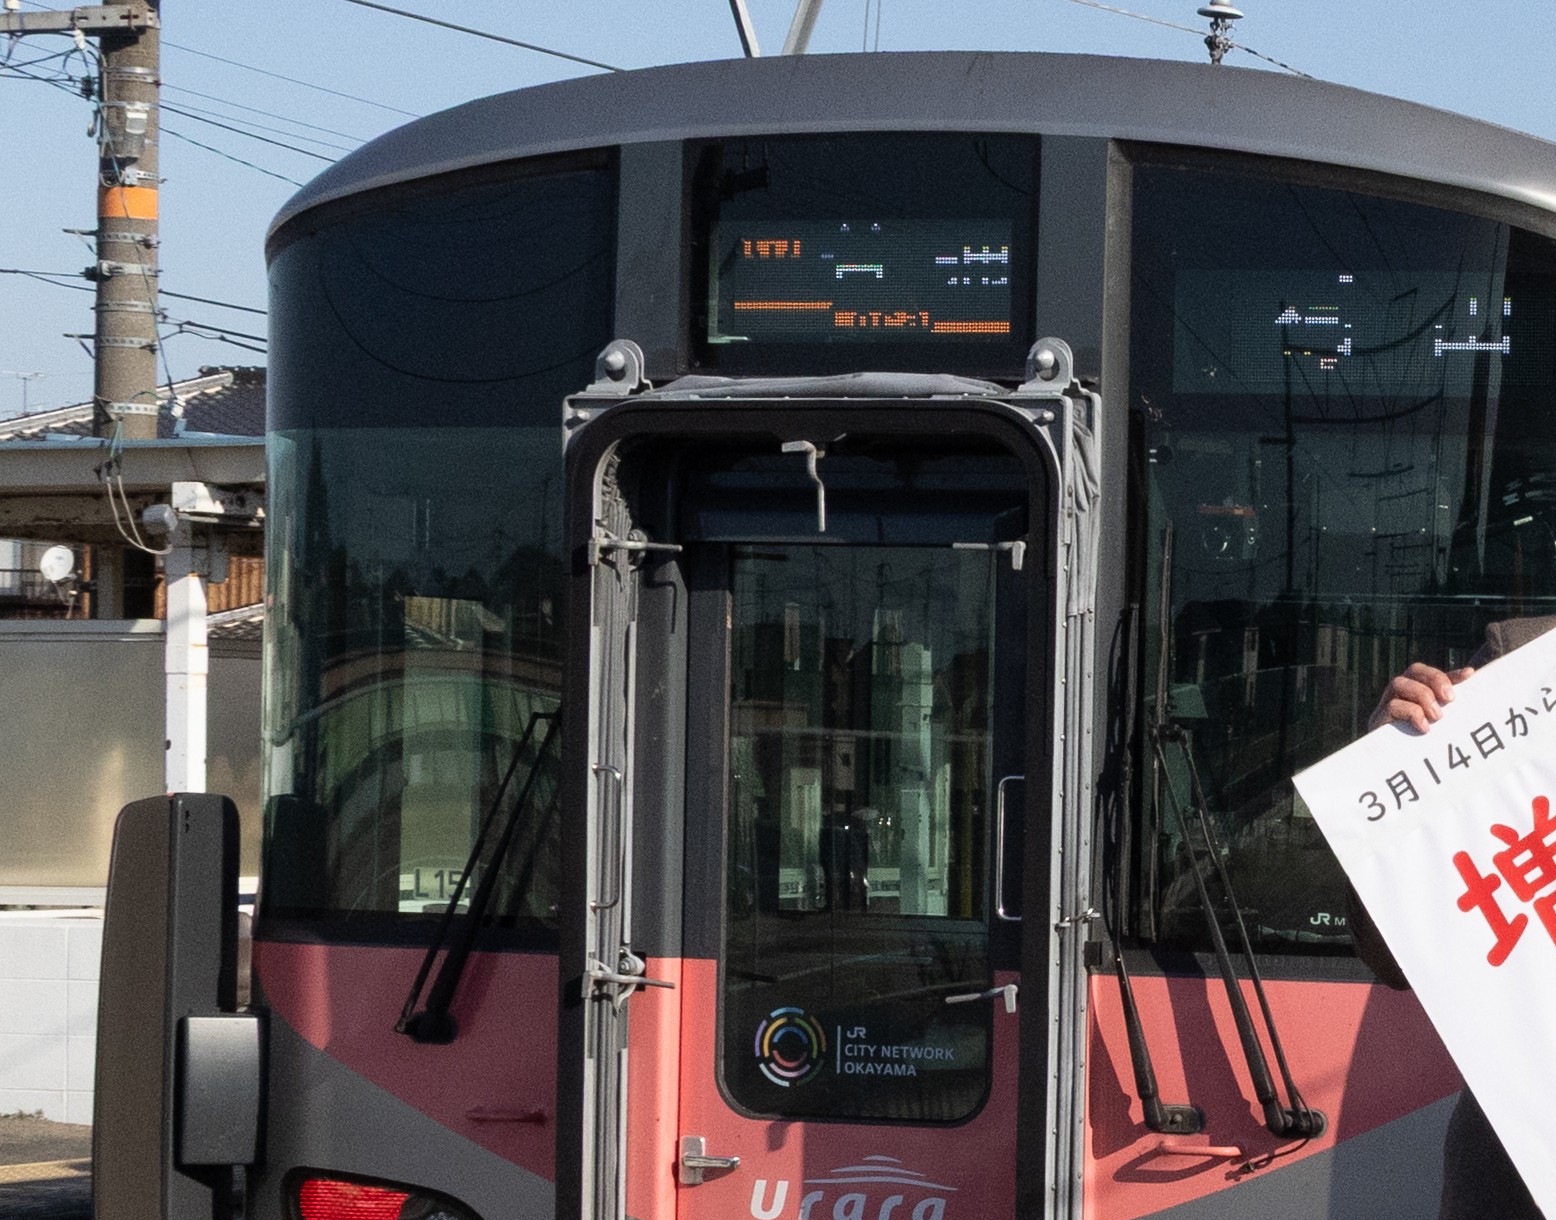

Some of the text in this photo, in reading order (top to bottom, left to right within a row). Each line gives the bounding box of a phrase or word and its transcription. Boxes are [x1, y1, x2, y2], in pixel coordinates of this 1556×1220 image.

[1309, 912, 1331, 926] JR
[846, 1026, 867, 1039] JR
[844, 1043, 955, 1060] CITY NETWORK
[844, 1061, 917, 1077] OKAYAMA
